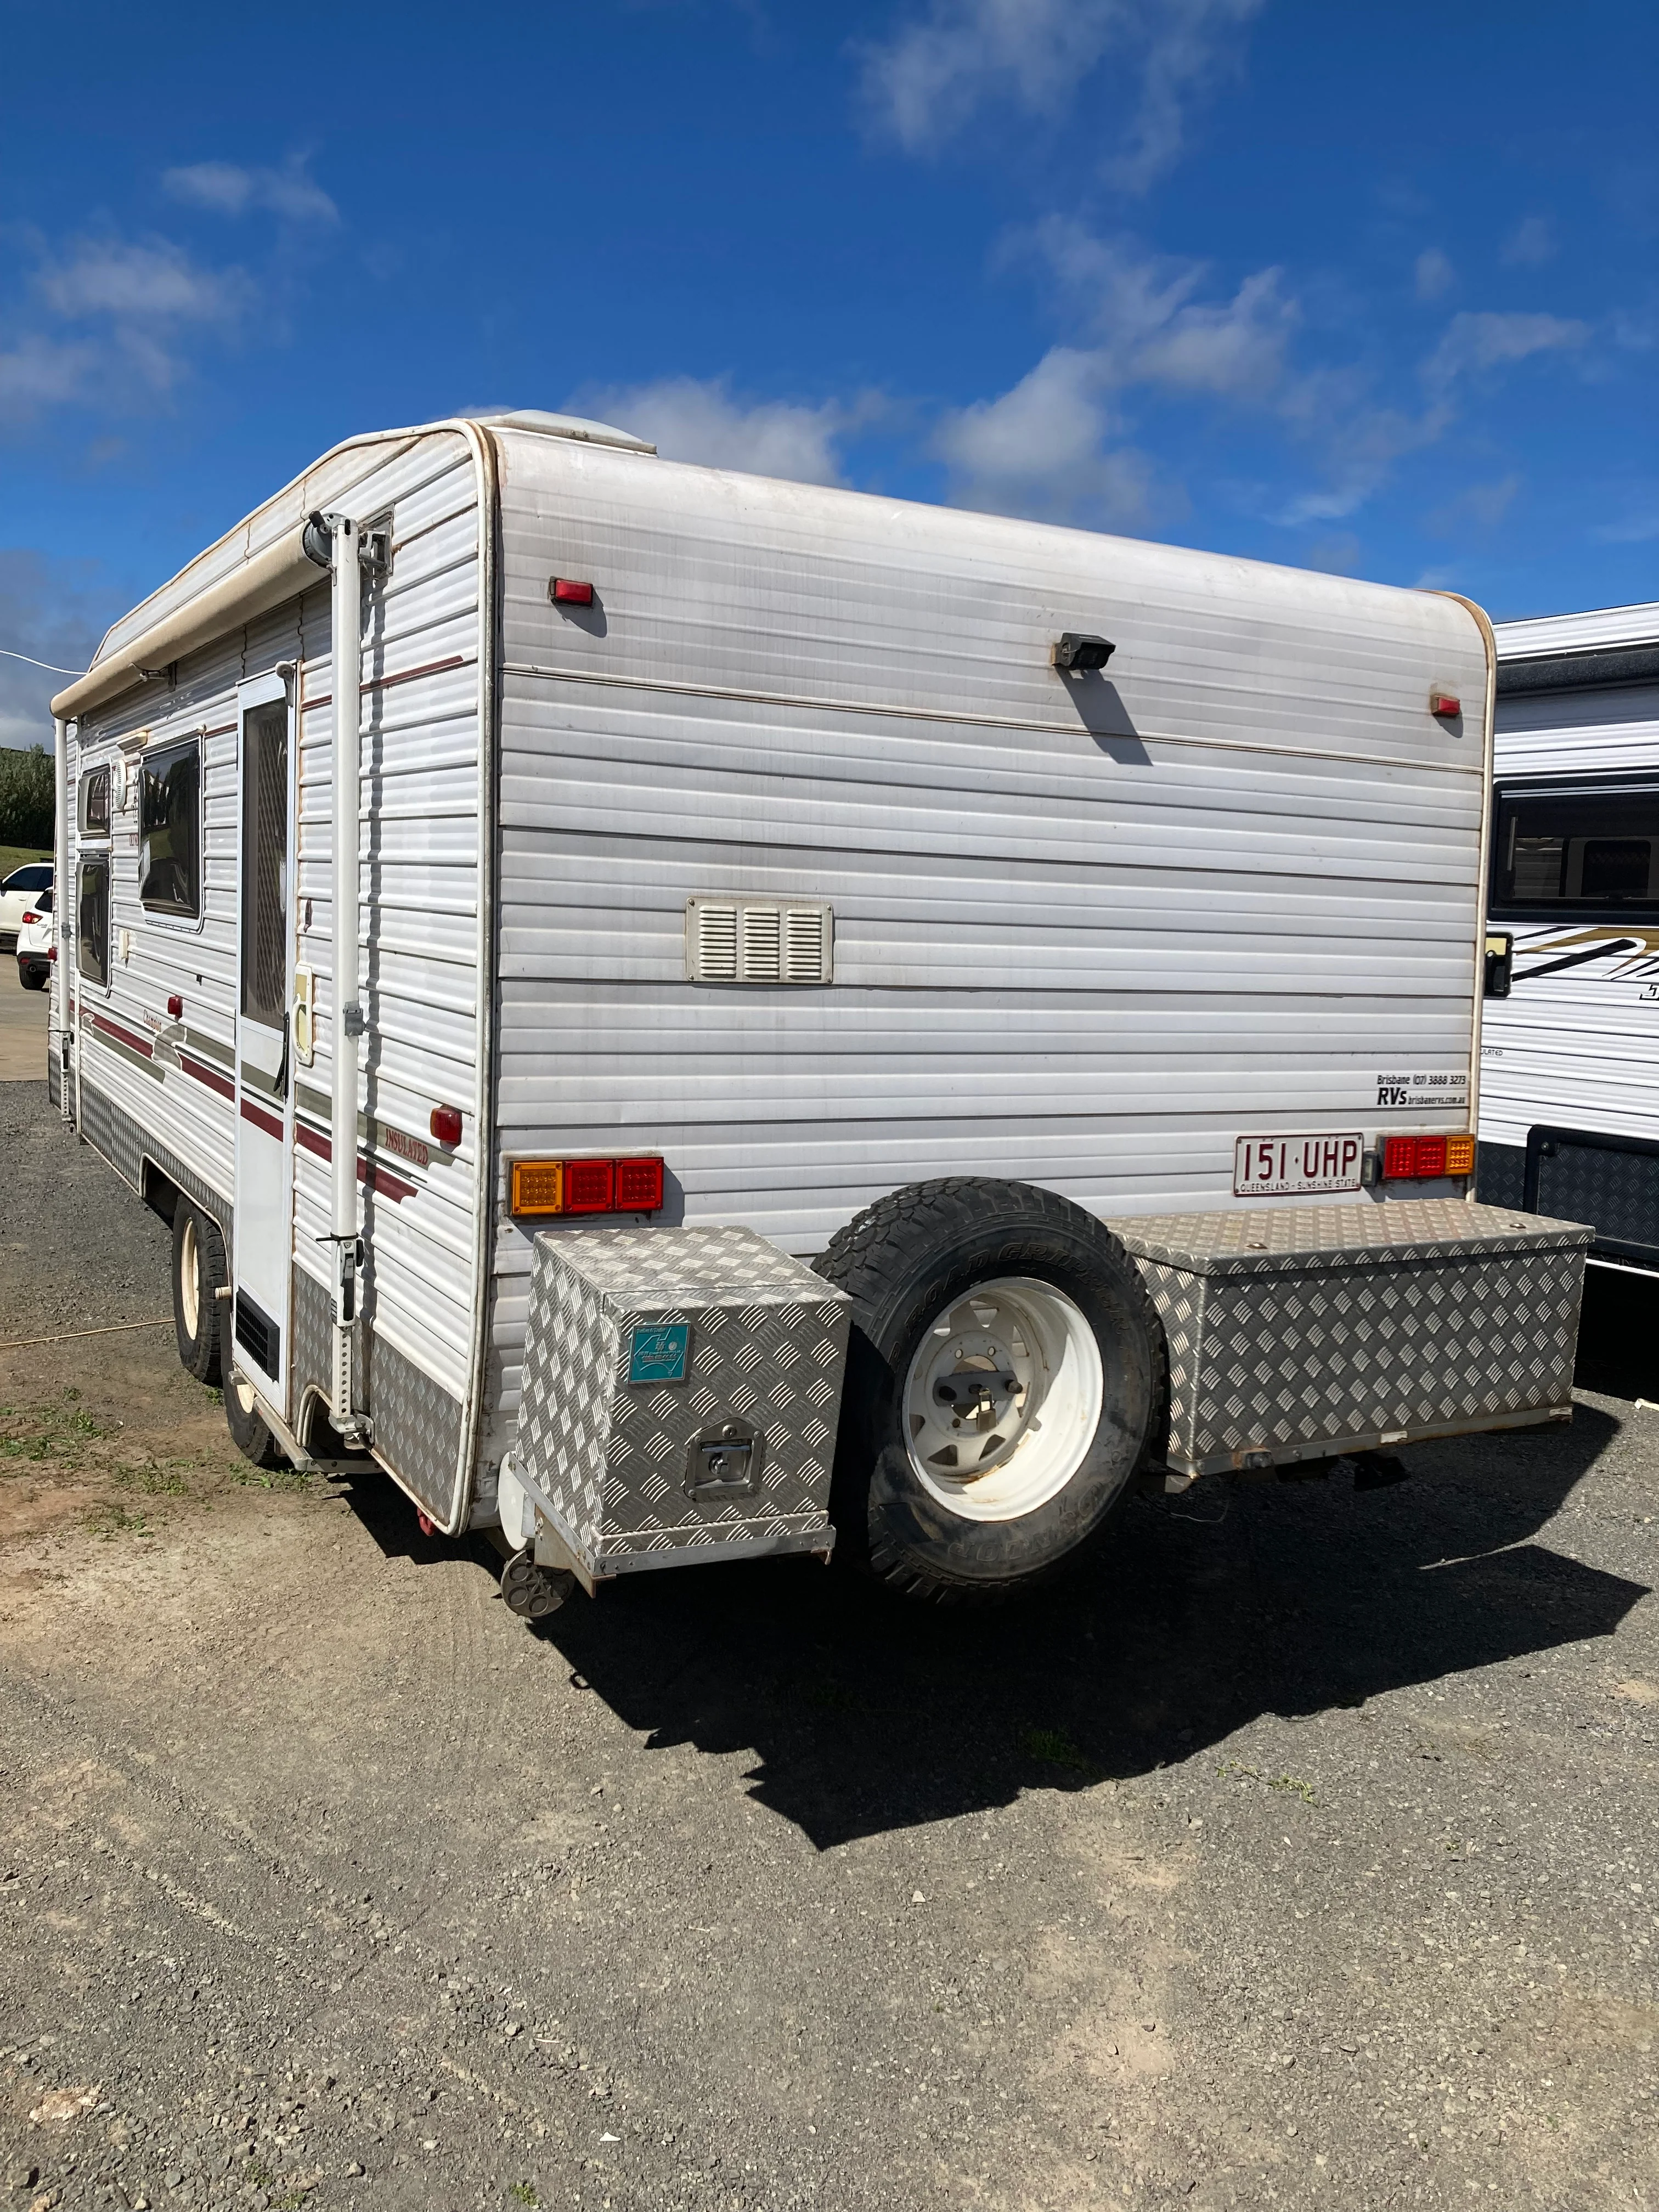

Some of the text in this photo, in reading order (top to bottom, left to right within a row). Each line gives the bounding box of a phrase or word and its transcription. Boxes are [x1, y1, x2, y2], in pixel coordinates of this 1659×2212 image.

[1377, 1074, 1466, 1085] Brisbane (07) 3888 3273
[1377, 1087, 1465, 1105] RVs brisbanervs.com.au
[385, 1128, 428, 1165] INSULATED
[1240, 1181, 1289, 1192] QUEENSLAND
[1297, 1180, 1332, 1190] SUNSHINE
[1335, 1178, 1356, 1188] STATE
[904, 1243, 1130, 1338] ROAD GRIPPER
